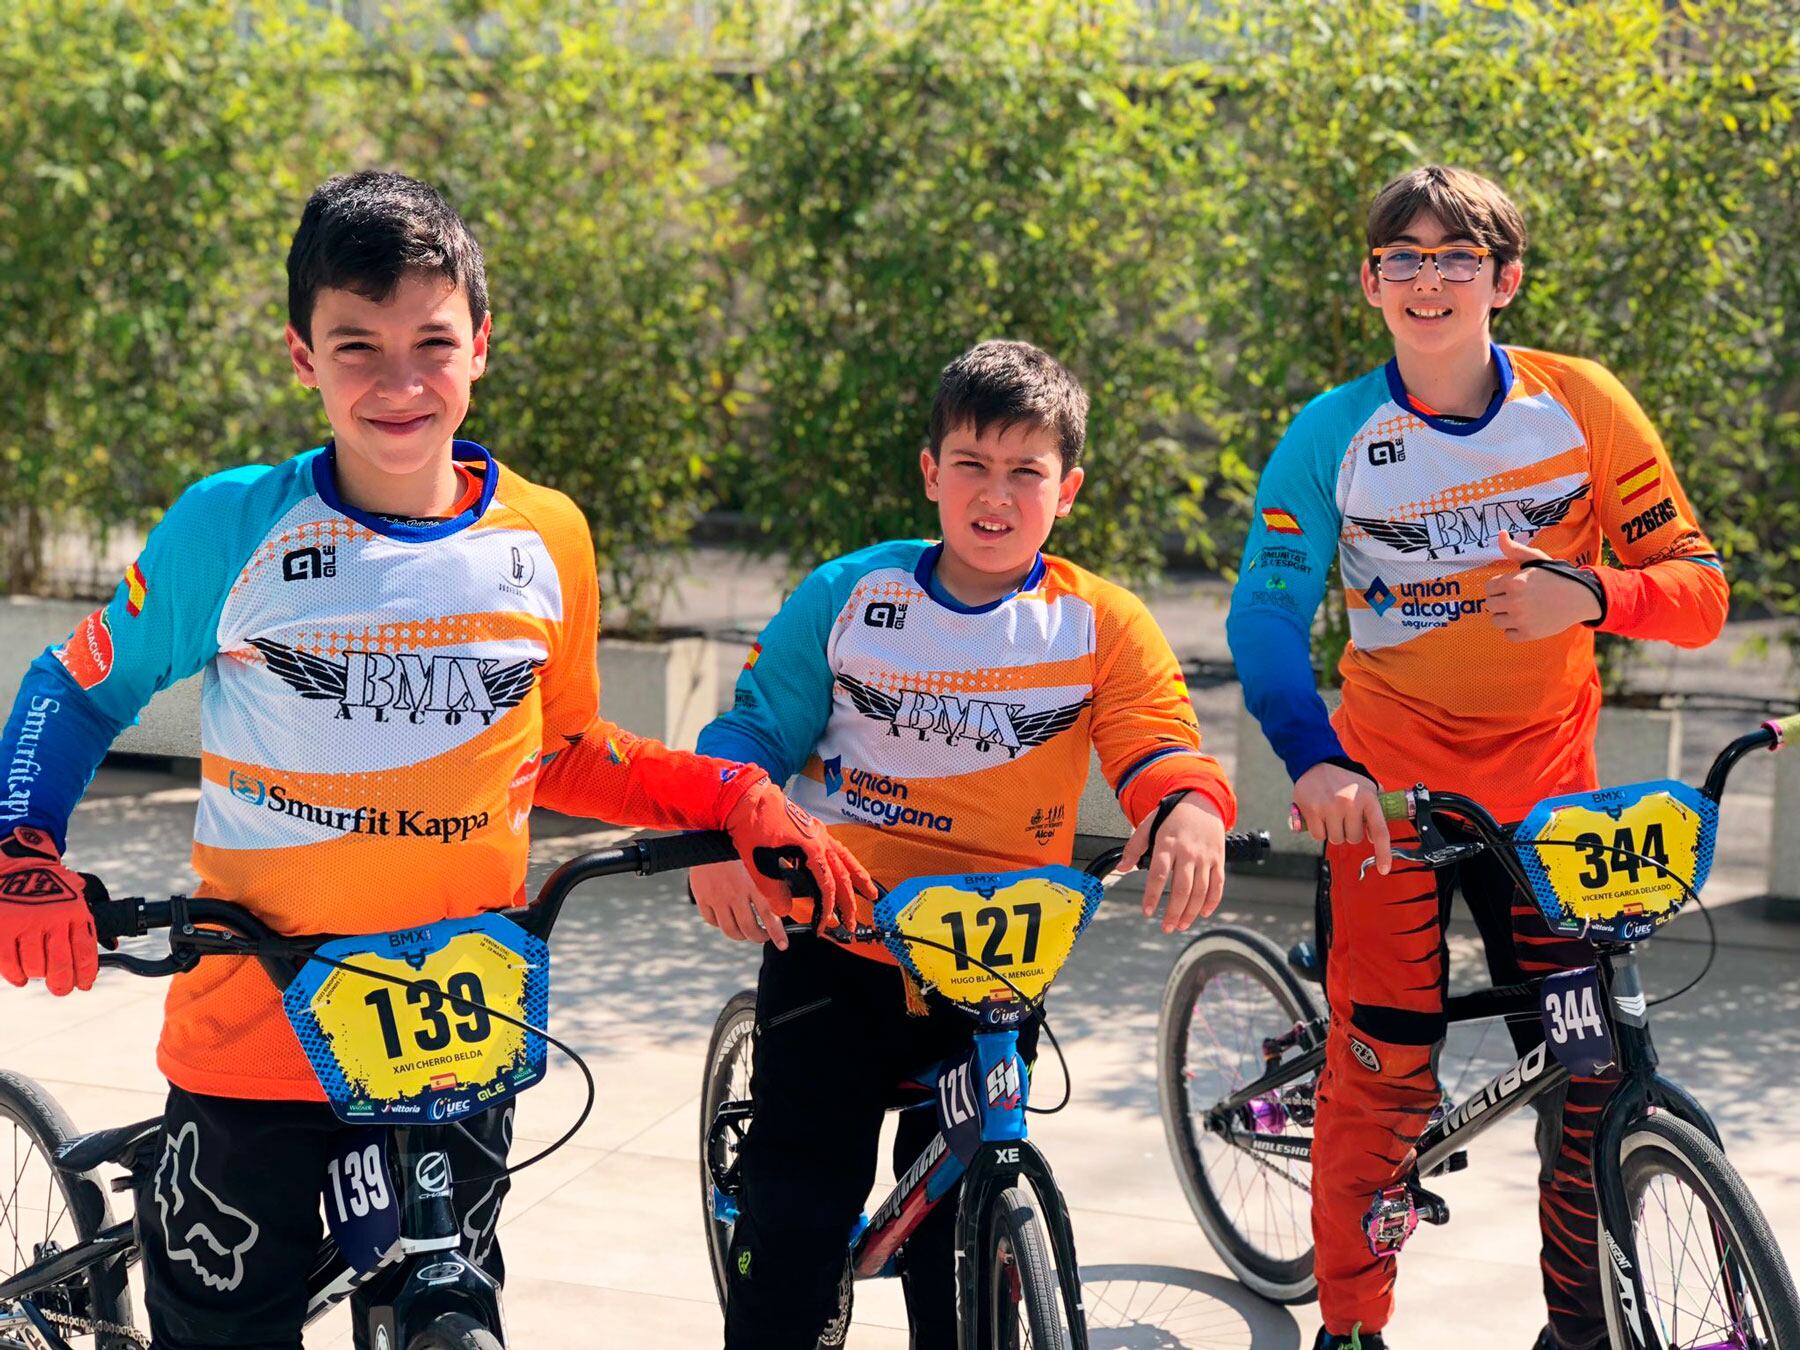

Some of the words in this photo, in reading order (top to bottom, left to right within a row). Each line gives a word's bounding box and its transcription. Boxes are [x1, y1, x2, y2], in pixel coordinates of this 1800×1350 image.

[1421, 498, 1542, 551] BMX
[1620, 497, 1678, 544] 226ERS
[1400, 577, 1460, 598] unión
[339, 651, 499, 713] BMX
[334, 701, 497, 726] ALCOY
[892, 688, 1025, 749] BMX
[886, 723, 1022, 759] ALCOY
[849, 767, 909, 800] unión
[1592, 790, 1620, 803] BMX
[267, 785, 390, 837] Smurfit
[395, 809, 490, 844] Kappa
[845, 788, 953, 833] alcoyana
[1574, 822, 1670, 890] 344
[964, 875, 995, 885] BMX
[1581, 892, 1613, 902] VICENTE
[1614, 888, 1641, 899] GARCIA
[1641, 883, 1672, 895] DELICADO
[388, 929, 425, 948] BMX
[940, 902, 1042, 972] 127
[1634, 923, 1652, 934] UEC
[950, 976, 975, 985] HUGO
[1008, 968, 1045, 980] MENGUAL
[364, 971, 492, 1059] 139
[1001, 1009, 1020, 1021] UEC
[1545, 986, 1604, 1044] 344
[393, 1062, 415, 1075] XAVI
[416, 1055, 453, 1070] CHERRO
[454, 1049, 483, 1062] BELDA
[446, 1099, 471, 1113] UEC
[938, 1062, 976, 1129] 127
[995, 1148, 1020, 1164] XE
[1252, 1139, 1314, 1158] HOLESHO
[327, 1144, 390, 1224] 139
